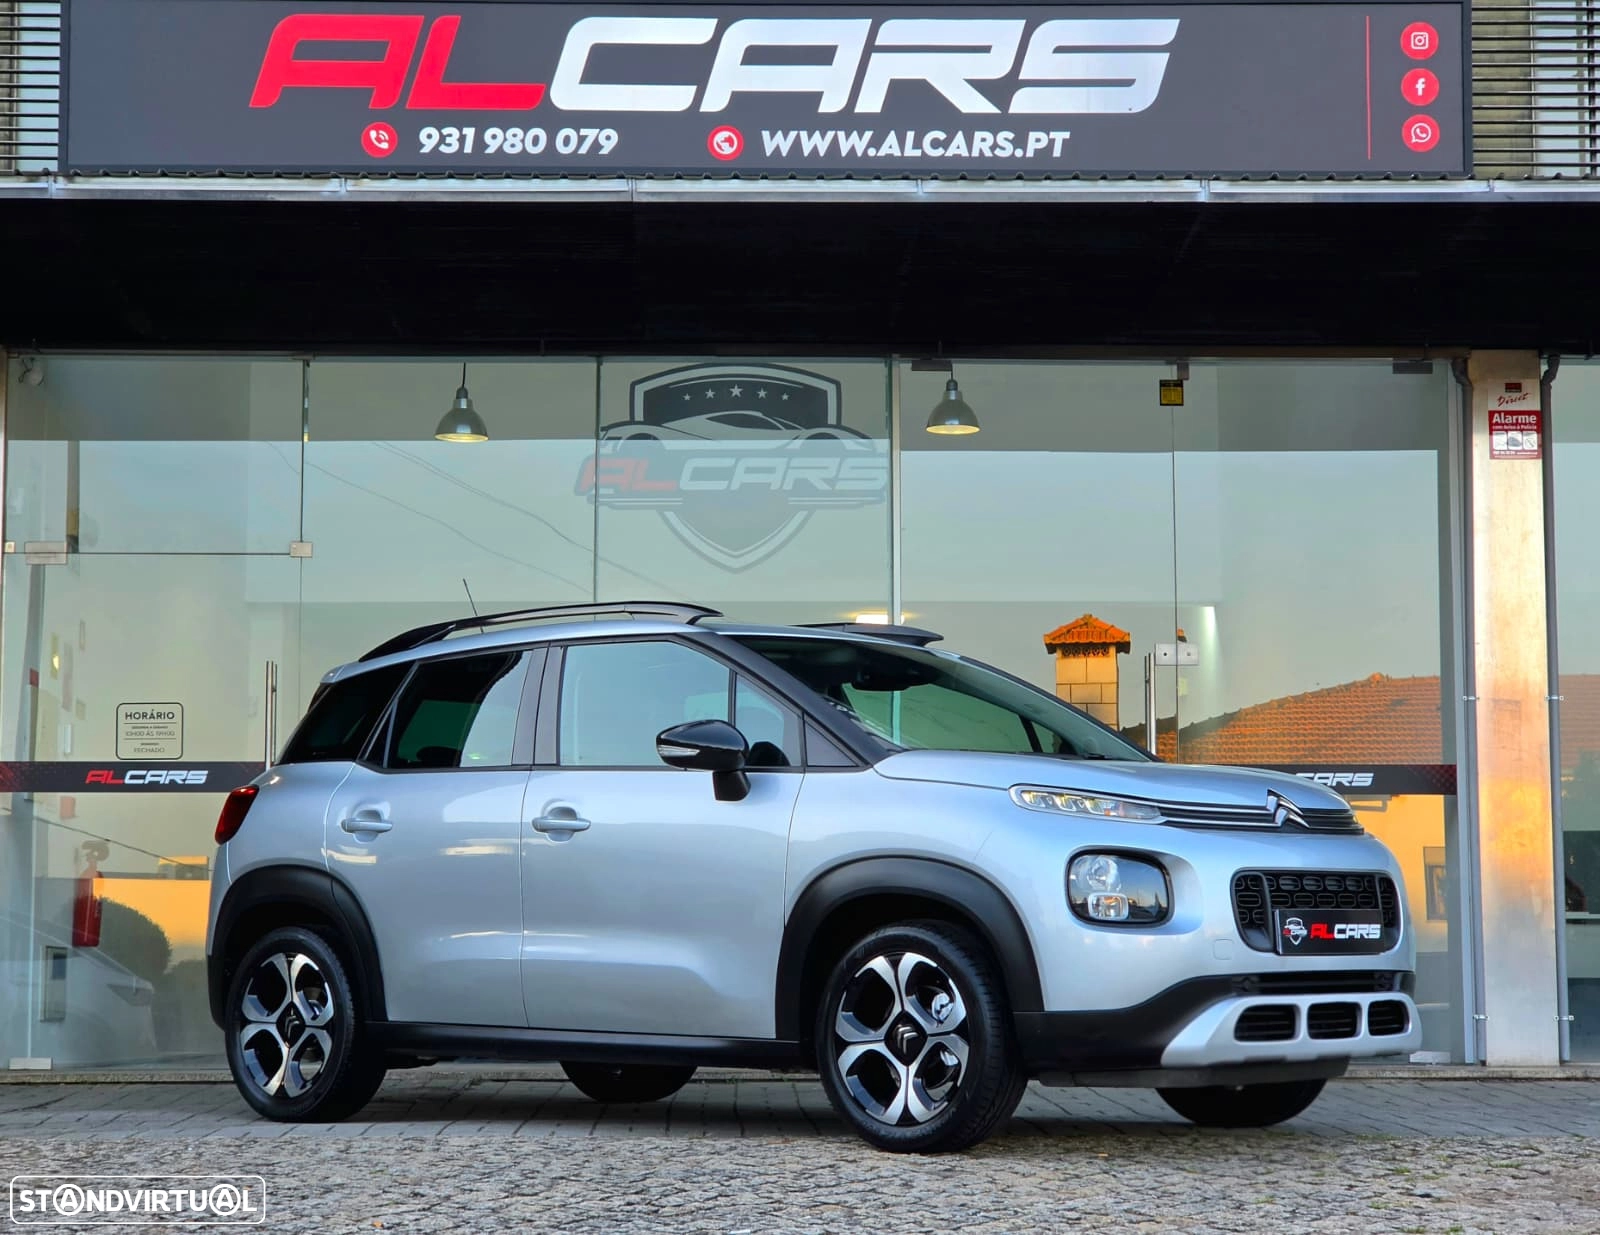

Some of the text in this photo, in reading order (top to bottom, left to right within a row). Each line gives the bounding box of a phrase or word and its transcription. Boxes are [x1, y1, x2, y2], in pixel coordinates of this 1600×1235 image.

[249, 14, 1180, 114] ALCARS
[419, 127, 619, 155] 931 980 079
[761, 129, 1070, 158] WWW.ALCARS.PT
[1492, 412, 1537, 424] Alarme
[579, 456, 889, 492] ALCARS
[124, 708, 175, 721] HORÁRIO
[85, 769, 209, 785] ALCARS
[1310, 923, 1382, 940] ALCARS
